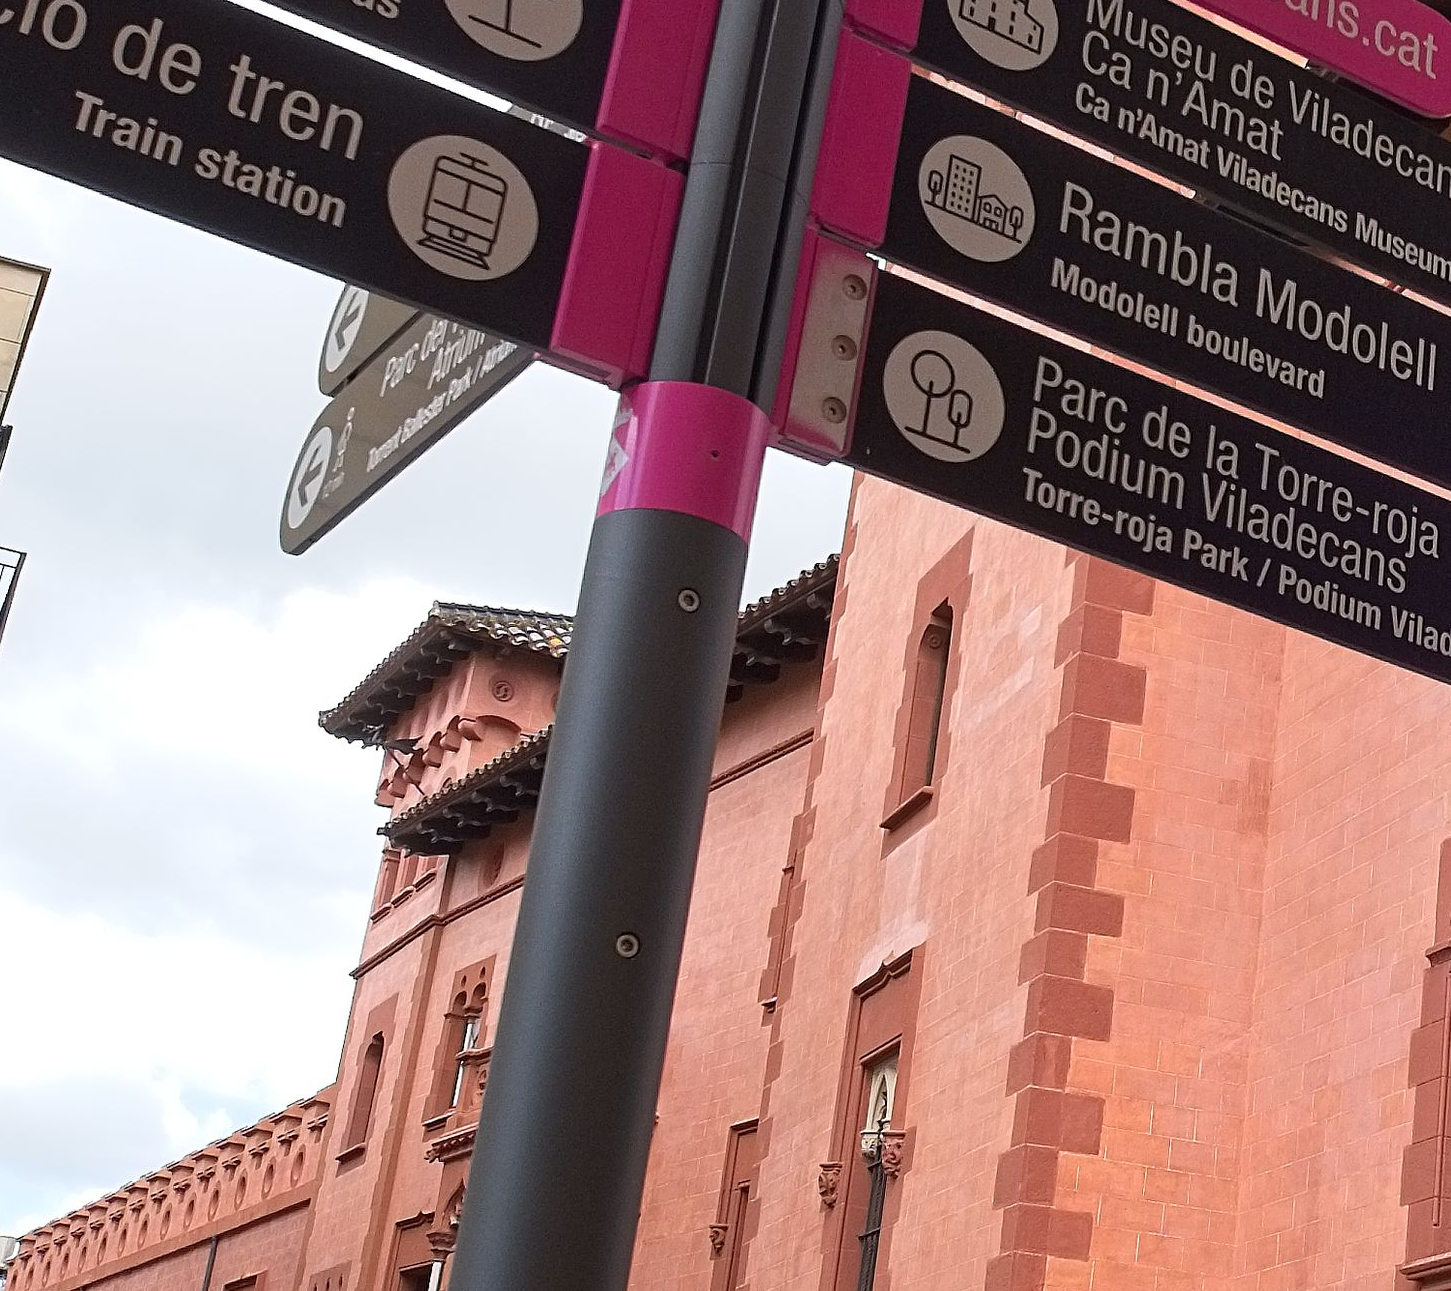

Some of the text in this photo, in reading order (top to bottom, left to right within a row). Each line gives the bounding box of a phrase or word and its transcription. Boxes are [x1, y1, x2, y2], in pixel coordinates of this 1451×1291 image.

[113, 18, 201, 94] de
[229, 55, 362, 160] tren
[1083, 31, 1131, 89] Ca
[1231, 60, 1274, 108] de
[76, 91, 345, 227] Train station
[1076, 83, 1109, 122] Ca
[1218, 146, 1347, 232] Viladecans
[1051, 258, 1324, 398] Modolell boulevard
[1060, 181, 1436, 390] Rambla Modolell
[380, 342, 420, 397] Parc
[1028, 407, 1406, 593] Podium Viladecans
[1034, 356, 1438, 558] Parc de la Torre-roja
[1023, 467, 1172, 552] Torre-roja
[1183, 528, 1248, 581] Park
[1257, 558, 1271, 587] /
[1279, 564, 1381, 630] Podium
